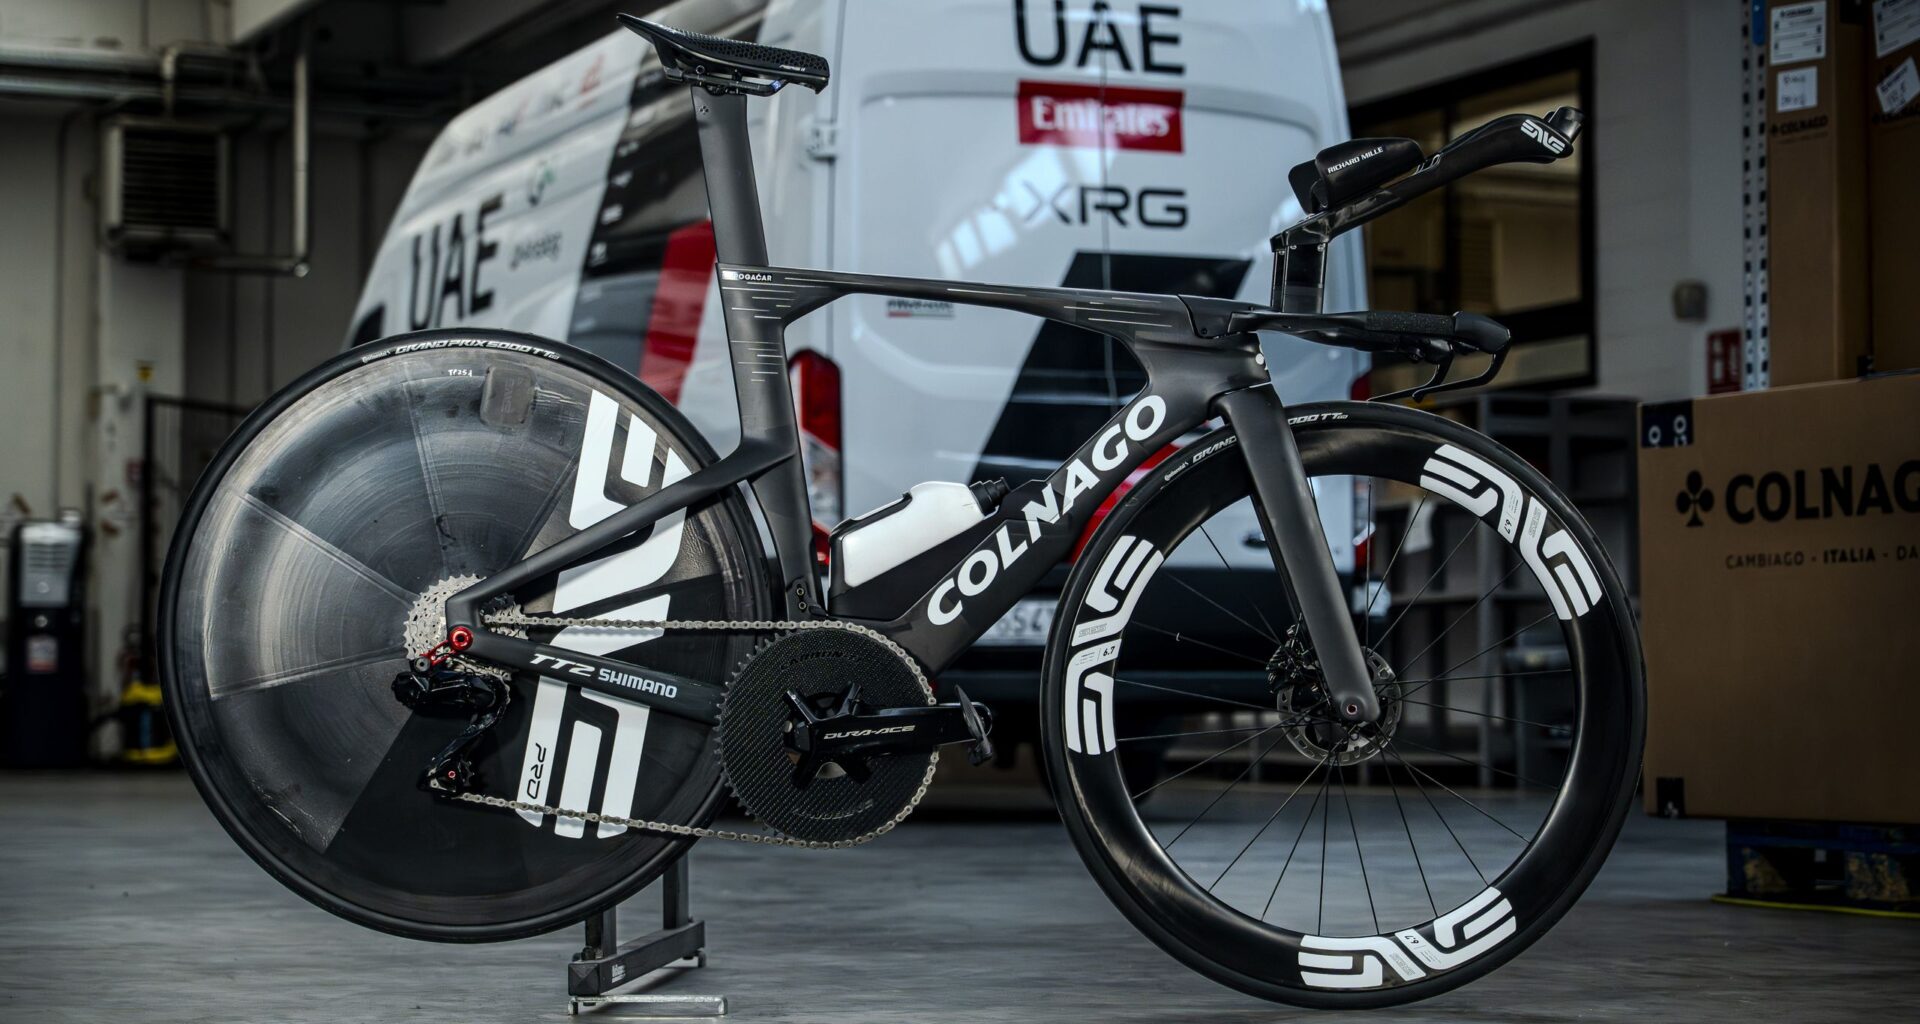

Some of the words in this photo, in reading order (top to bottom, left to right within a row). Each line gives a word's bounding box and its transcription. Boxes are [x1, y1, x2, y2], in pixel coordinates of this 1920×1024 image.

[1014, 0, 1186, 76] UAE
[1327, 156, 1360, 174] RICHARD
[1361, 145, 1384, 163] MILLE
[1023, 180, 1188, 229] XRG
[409, 193, 504, 332] UAE
[732, 273, 772, 283] OGAČAR
[395, 340, 446, 355] GRAND
[447, 338, 488, 348] PRIX
[1192, 434, 1238, 463] GRAND
[1287, 414, 1318, 426] 000
[927, 395, 1167, 626] COLNAGO
[1725, 551, 1805, 570] CAMBIAGO
[1823, 547, 1877, 565] ITALIA
[1102, 645, 1115, 657] 6.7
[597, 668, 678, 700] SHIMANO
[823, 723, 916, 740] DURA-ACE
[526, 742, 547, 800] PRO
